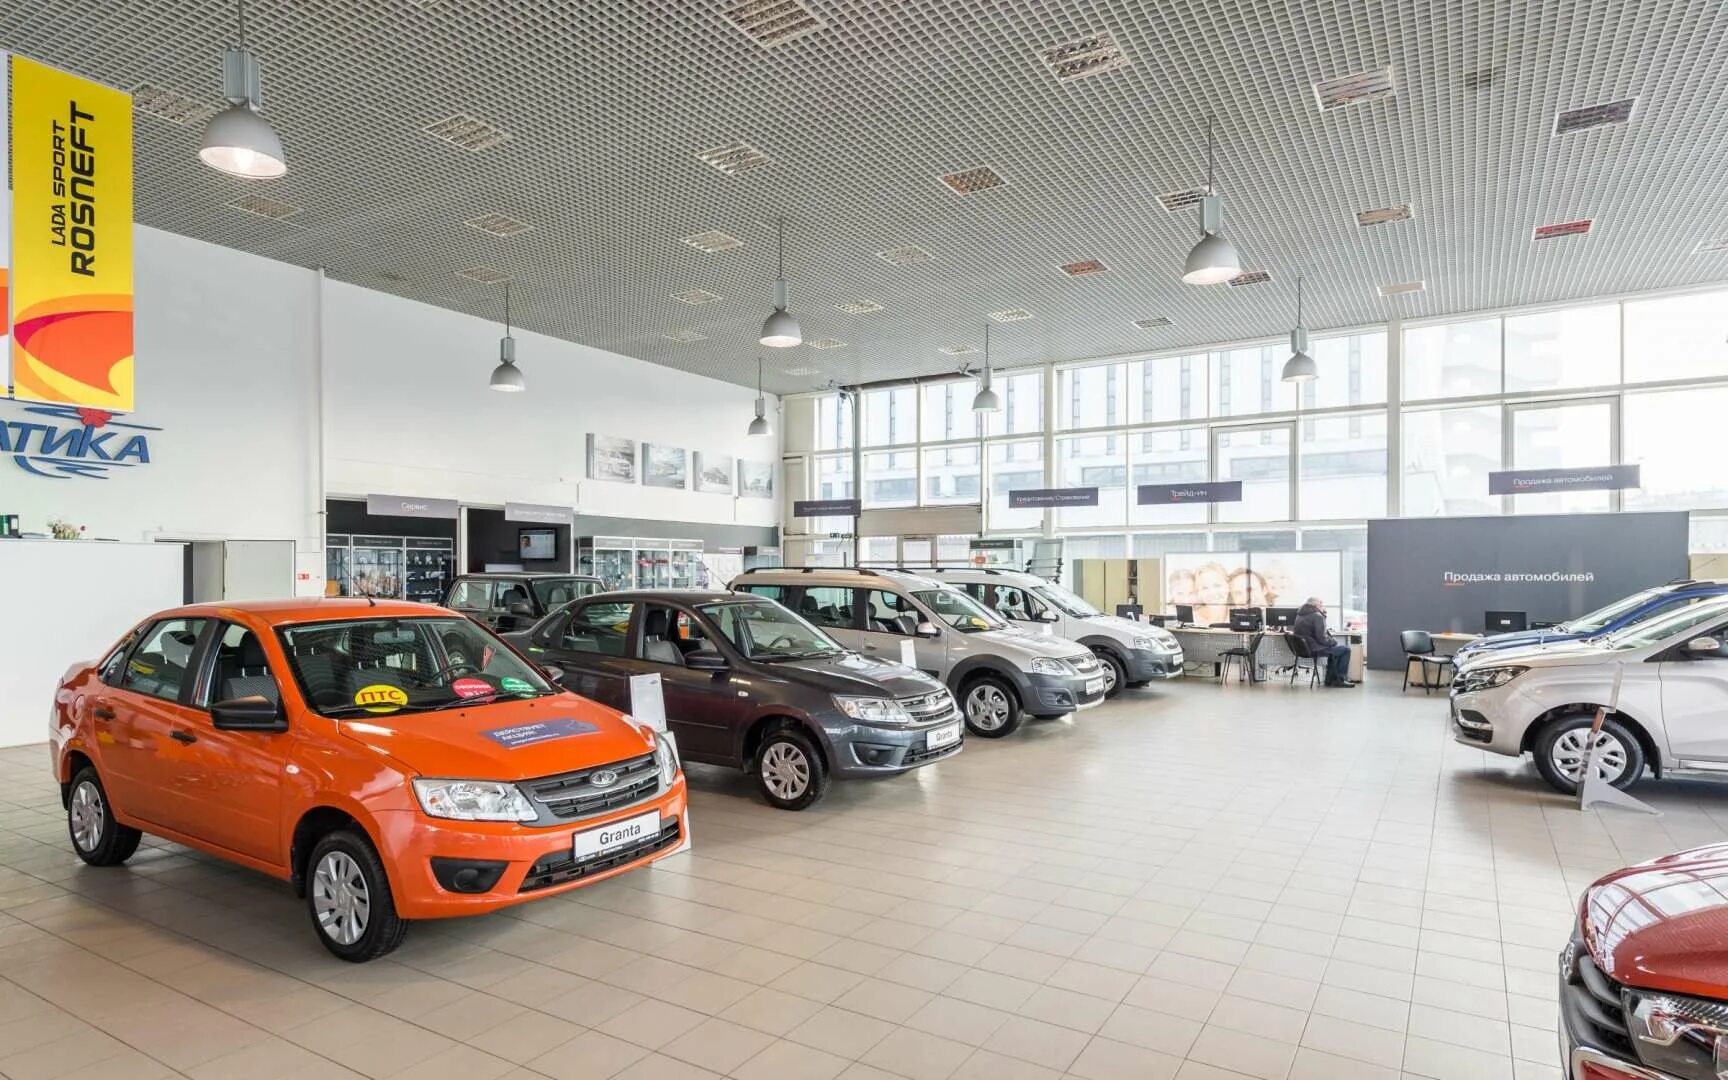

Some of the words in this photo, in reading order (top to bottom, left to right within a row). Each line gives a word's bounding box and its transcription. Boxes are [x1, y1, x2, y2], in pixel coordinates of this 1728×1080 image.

[52, 119, 66, 198] SPORT
[69, 100, 96, 277] ROSNEFT
[51, 204, 66, 247] LADA
[1513, 478, 1551, 486] Продажа
[1553, 474, 1613, 484] автомобилей
[1444, 571, 1501, 583] Продажа
[1503, 571, 1594, 582] автомобилей
[360, 690, 401, 702] ПТС
[936, 730, 953, 742] Granta
[599, 823, 641, 845] Granta
